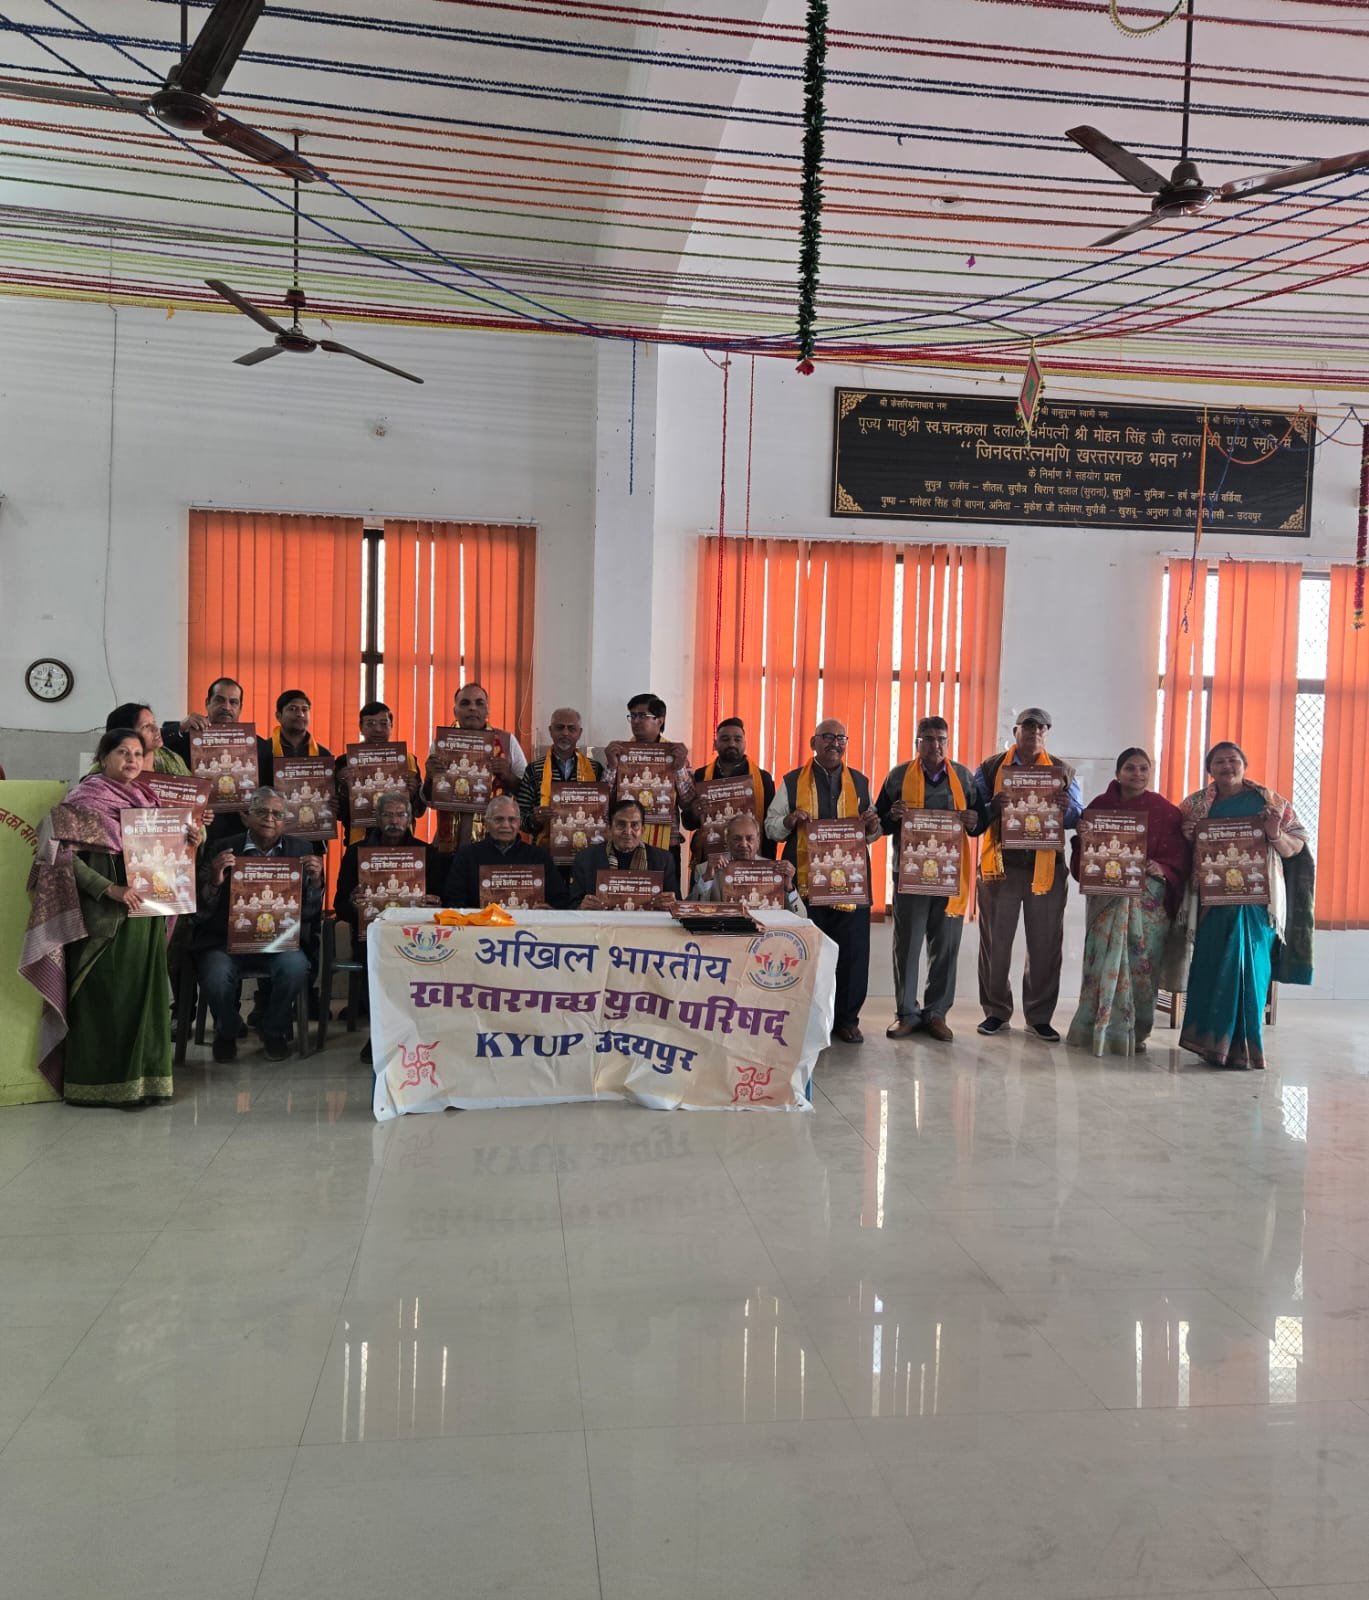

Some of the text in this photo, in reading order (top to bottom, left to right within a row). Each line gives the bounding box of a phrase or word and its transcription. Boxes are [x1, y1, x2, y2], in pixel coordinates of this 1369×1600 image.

[858, 417, 881, 435] पूज्य
[886, 416, 920, 437] मातुश्री
[1075, 425, 1088, 441] श्री
[1092, 425, 1120, 443] मोहन
[1125, 426, 1147, 445] सिंह
[1151, 428, 1166, 446] जी
[1170, 433, 1202, 447] दलाल
[1028, 466, 1036, 478] के
[1040, 466, 1062, 480] निर्माण
[1074, 469, 1101, 482] सहयोग
[1058, 486, 1078, 496] दलाल
[475, 930, 599, 973] अखिल
[608, 942, 731, 984] भारतीय
[410, 981, 790, 1047] खरतरगच्छ युवा परिषद्
[475, 1031, 698, 1075] KYUP उदयपुर
